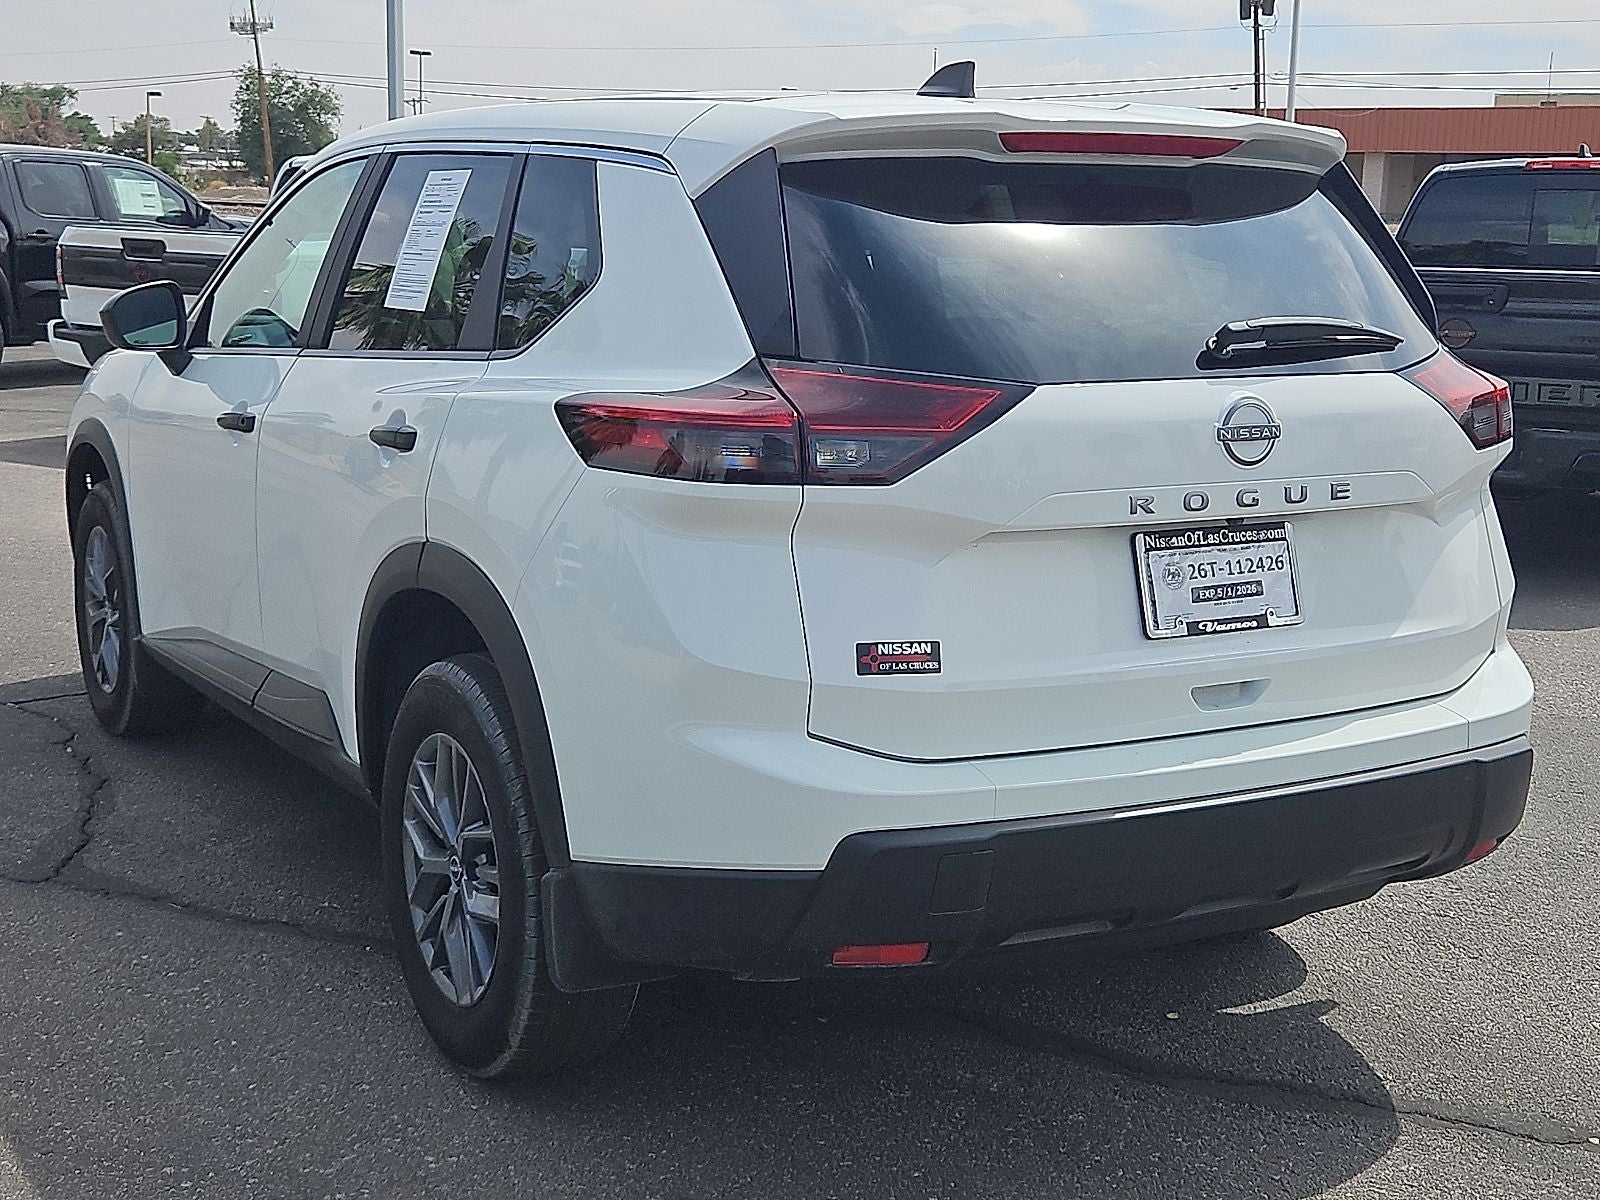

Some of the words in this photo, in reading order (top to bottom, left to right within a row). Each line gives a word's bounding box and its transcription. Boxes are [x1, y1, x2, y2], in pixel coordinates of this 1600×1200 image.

[1220, 426, 1280, 440] NISSAN
[1129, 480, 1352, 515] ROGUE
[1145, 526, 1286, 549] NissanOfLasCrucescom
[1187, 554, 1285, 581] 26T-112426
[1199, 588, 1216, 600] EXP
[1216, 584, 1258, 598] 5/1/2026
[1198, 619, 1258, 632] Vamos
[878, 643, 931, 655] NISSAN
[893, 662, 908, 670] LAS
[908, 661, 939, 670] CRUCES
